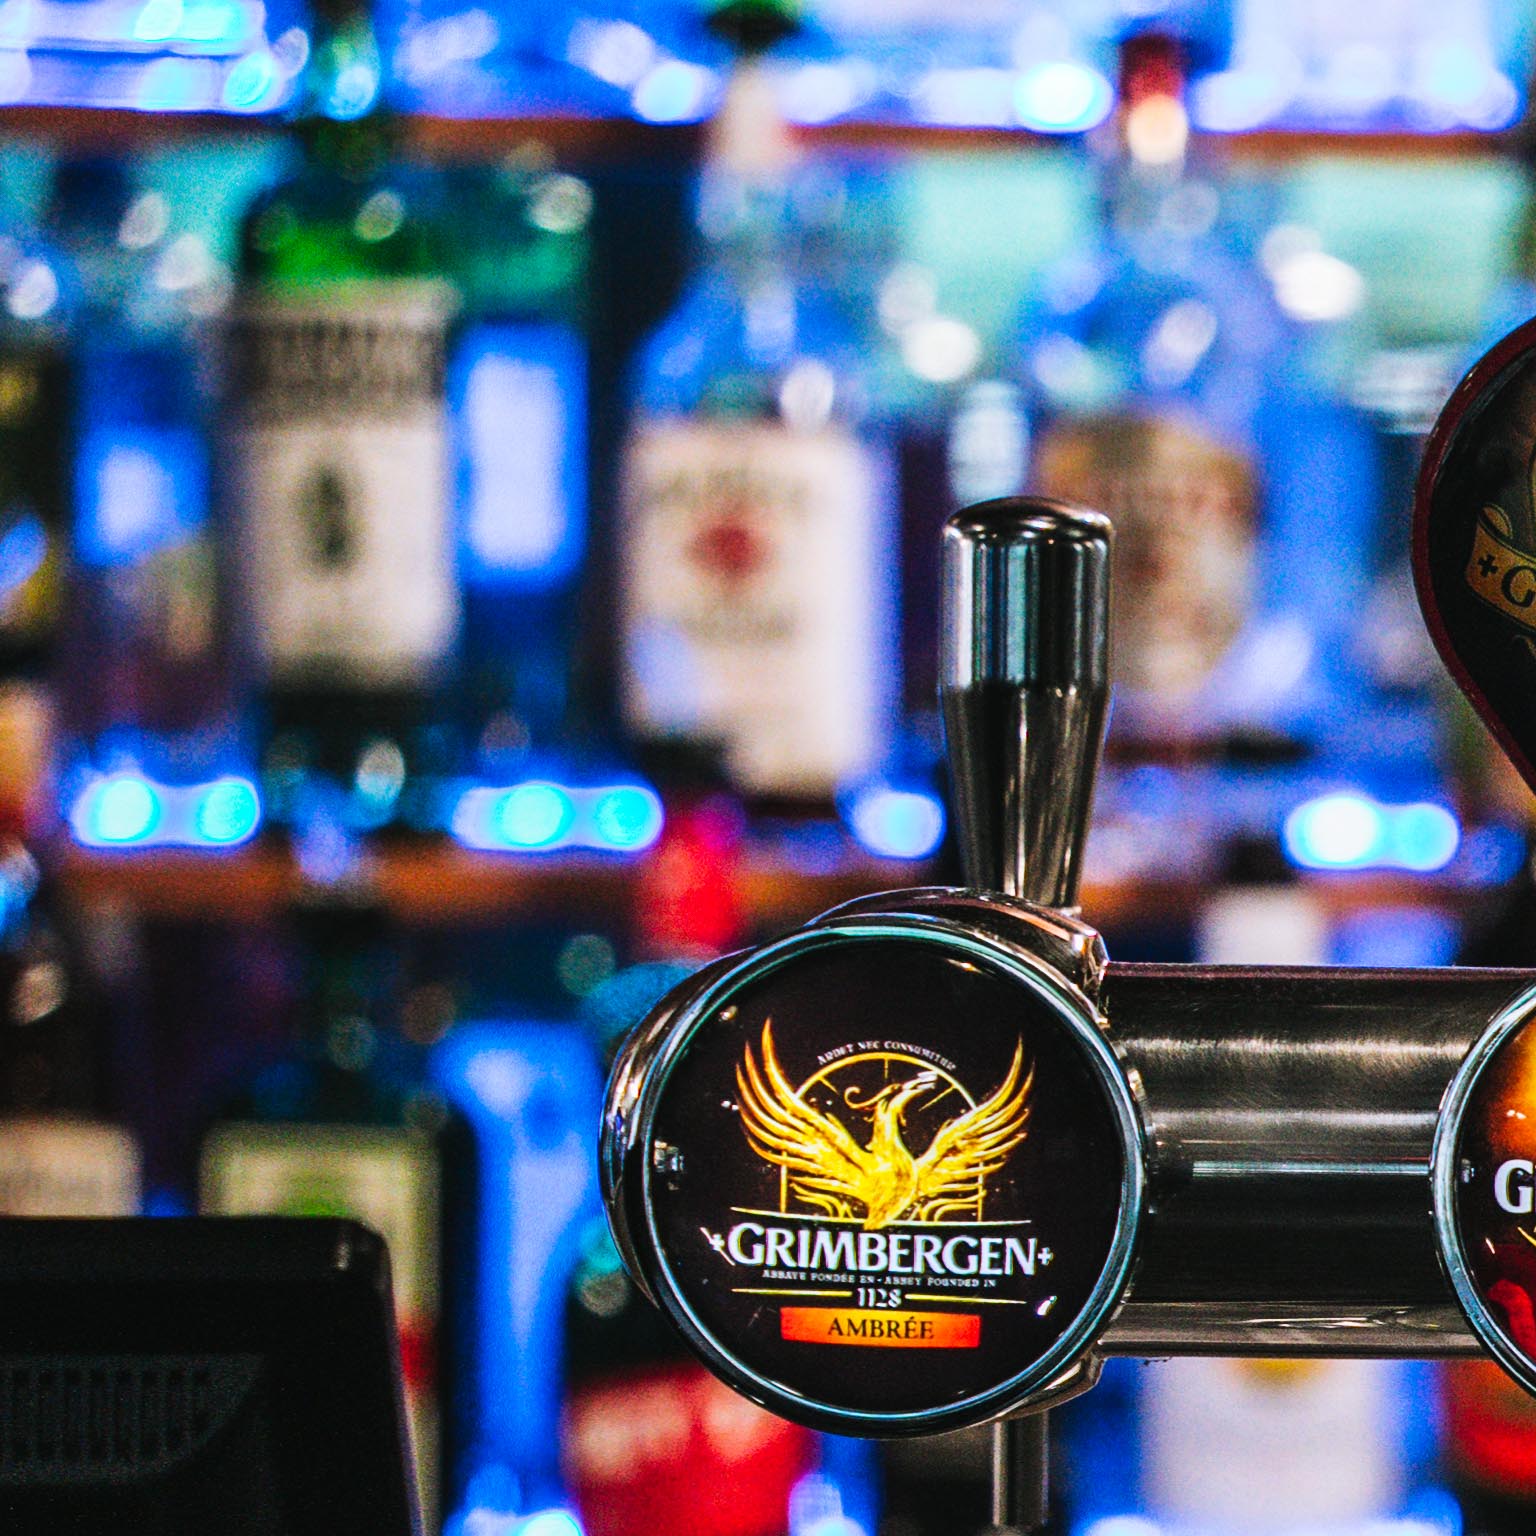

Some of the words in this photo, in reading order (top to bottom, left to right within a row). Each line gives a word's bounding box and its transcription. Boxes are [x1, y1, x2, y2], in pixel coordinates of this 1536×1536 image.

[727, 1221, 1038, 1277] GRIMBERGEN
[857, 1287, 903, 1308] 1128
[827, 1315, 935, 1340] AMBRÉE
